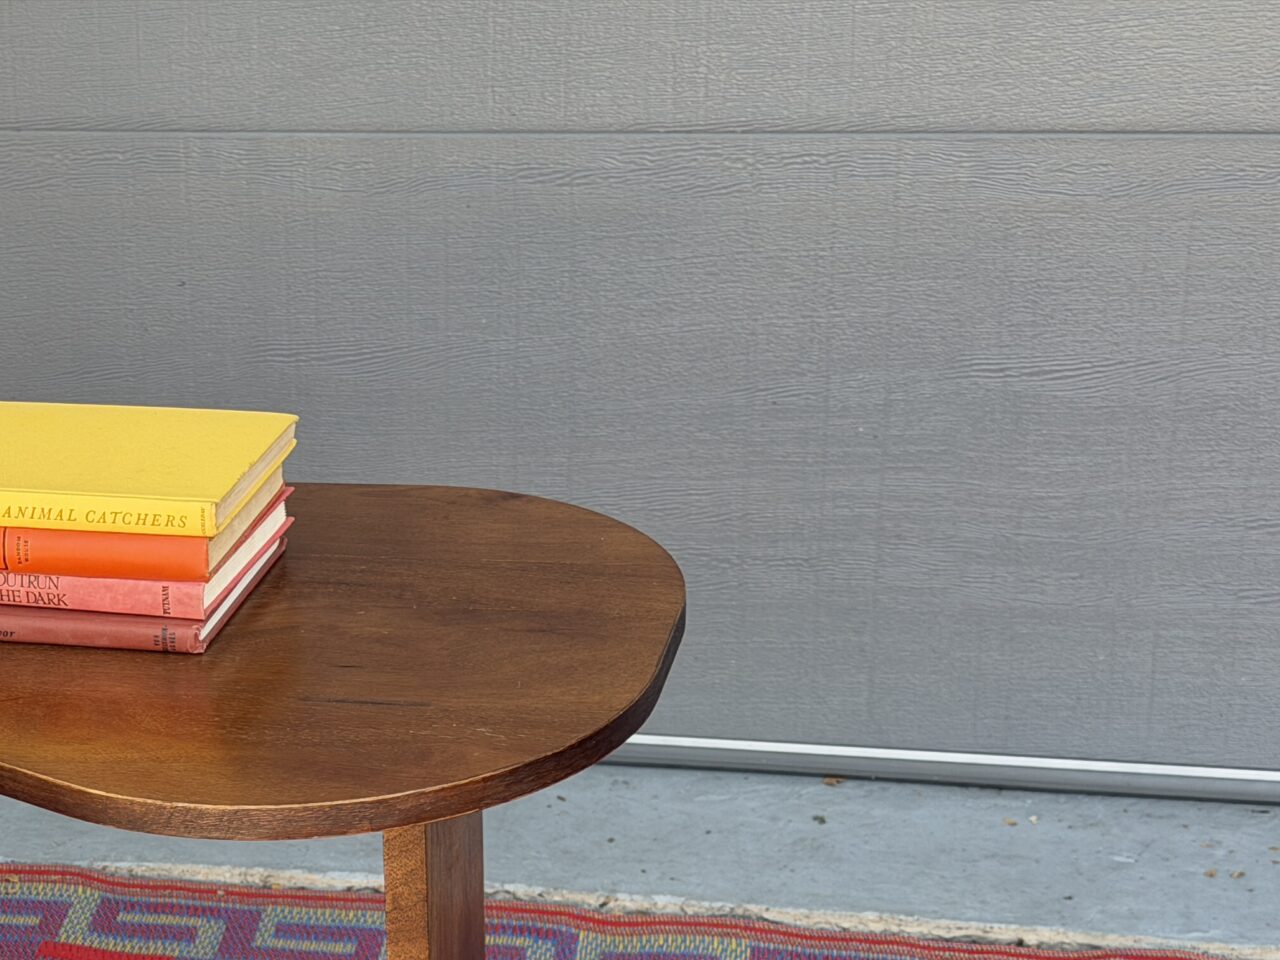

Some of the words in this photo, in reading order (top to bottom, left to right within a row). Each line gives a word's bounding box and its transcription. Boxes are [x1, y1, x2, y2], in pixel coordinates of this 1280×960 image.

[1, 505, 77, 522] ANIMAL
[85, 510, 188, 529] CATCHERS
[25, 589, 69, 607] DARK
